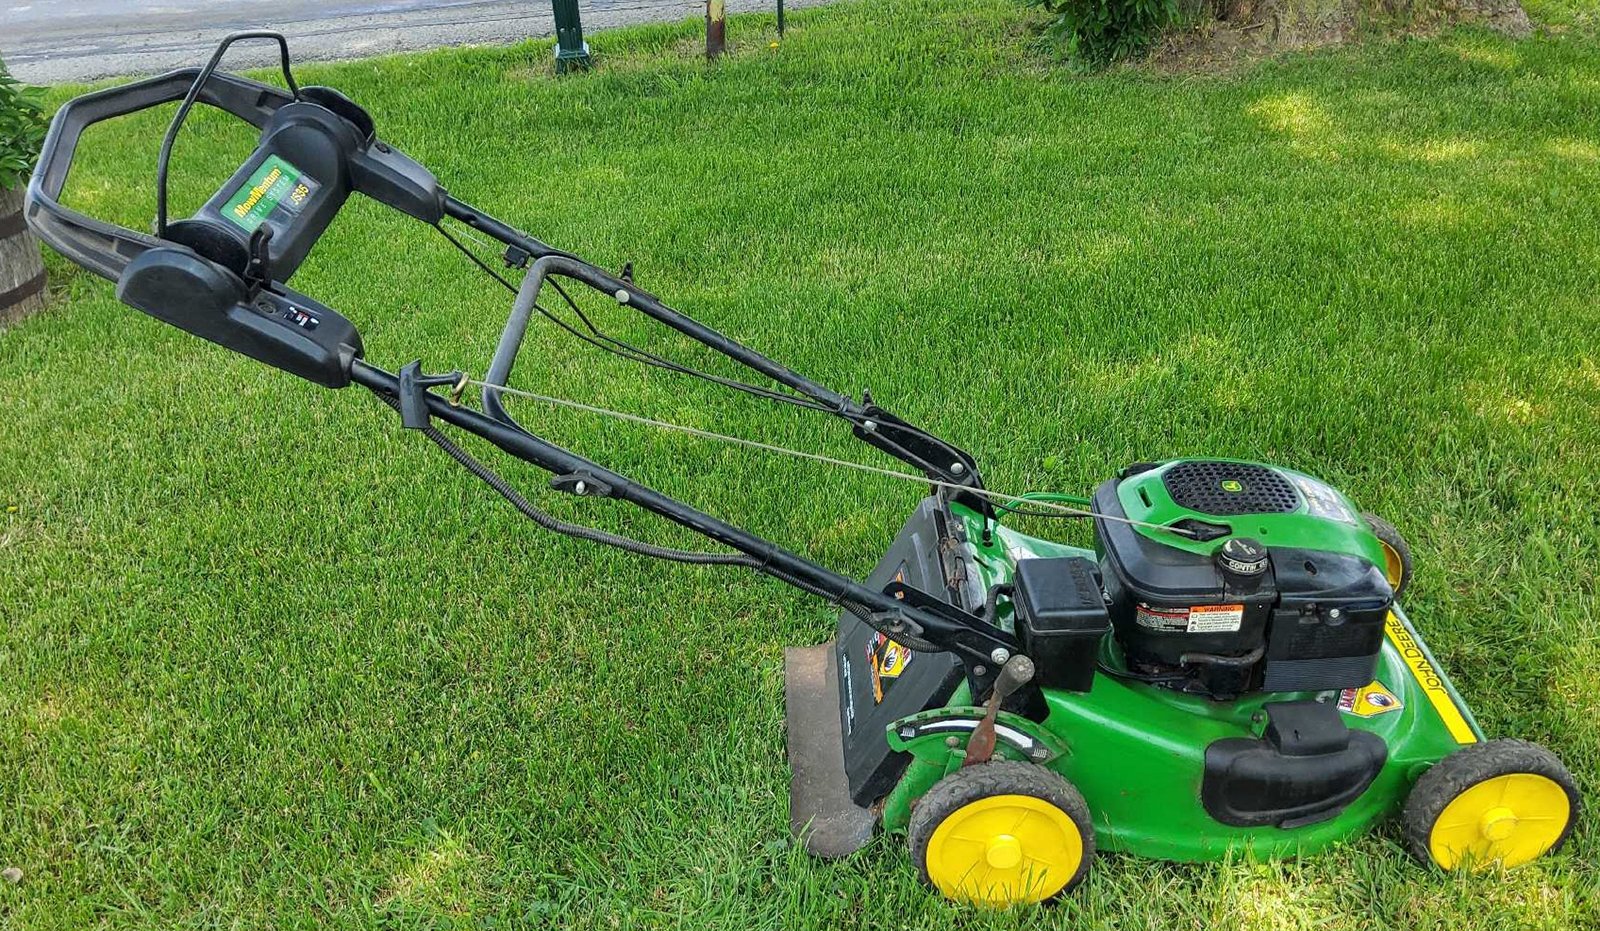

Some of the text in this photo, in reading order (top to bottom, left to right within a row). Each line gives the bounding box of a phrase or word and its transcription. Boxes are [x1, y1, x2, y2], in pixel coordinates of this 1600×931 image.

[266, 175, 290, 200] SYSTEM
[290, 183, 310, 206] JS35
[1203, 605, 1235, 613] WARNING
[1386, 620, 1447, 695] JOHN DEERE
